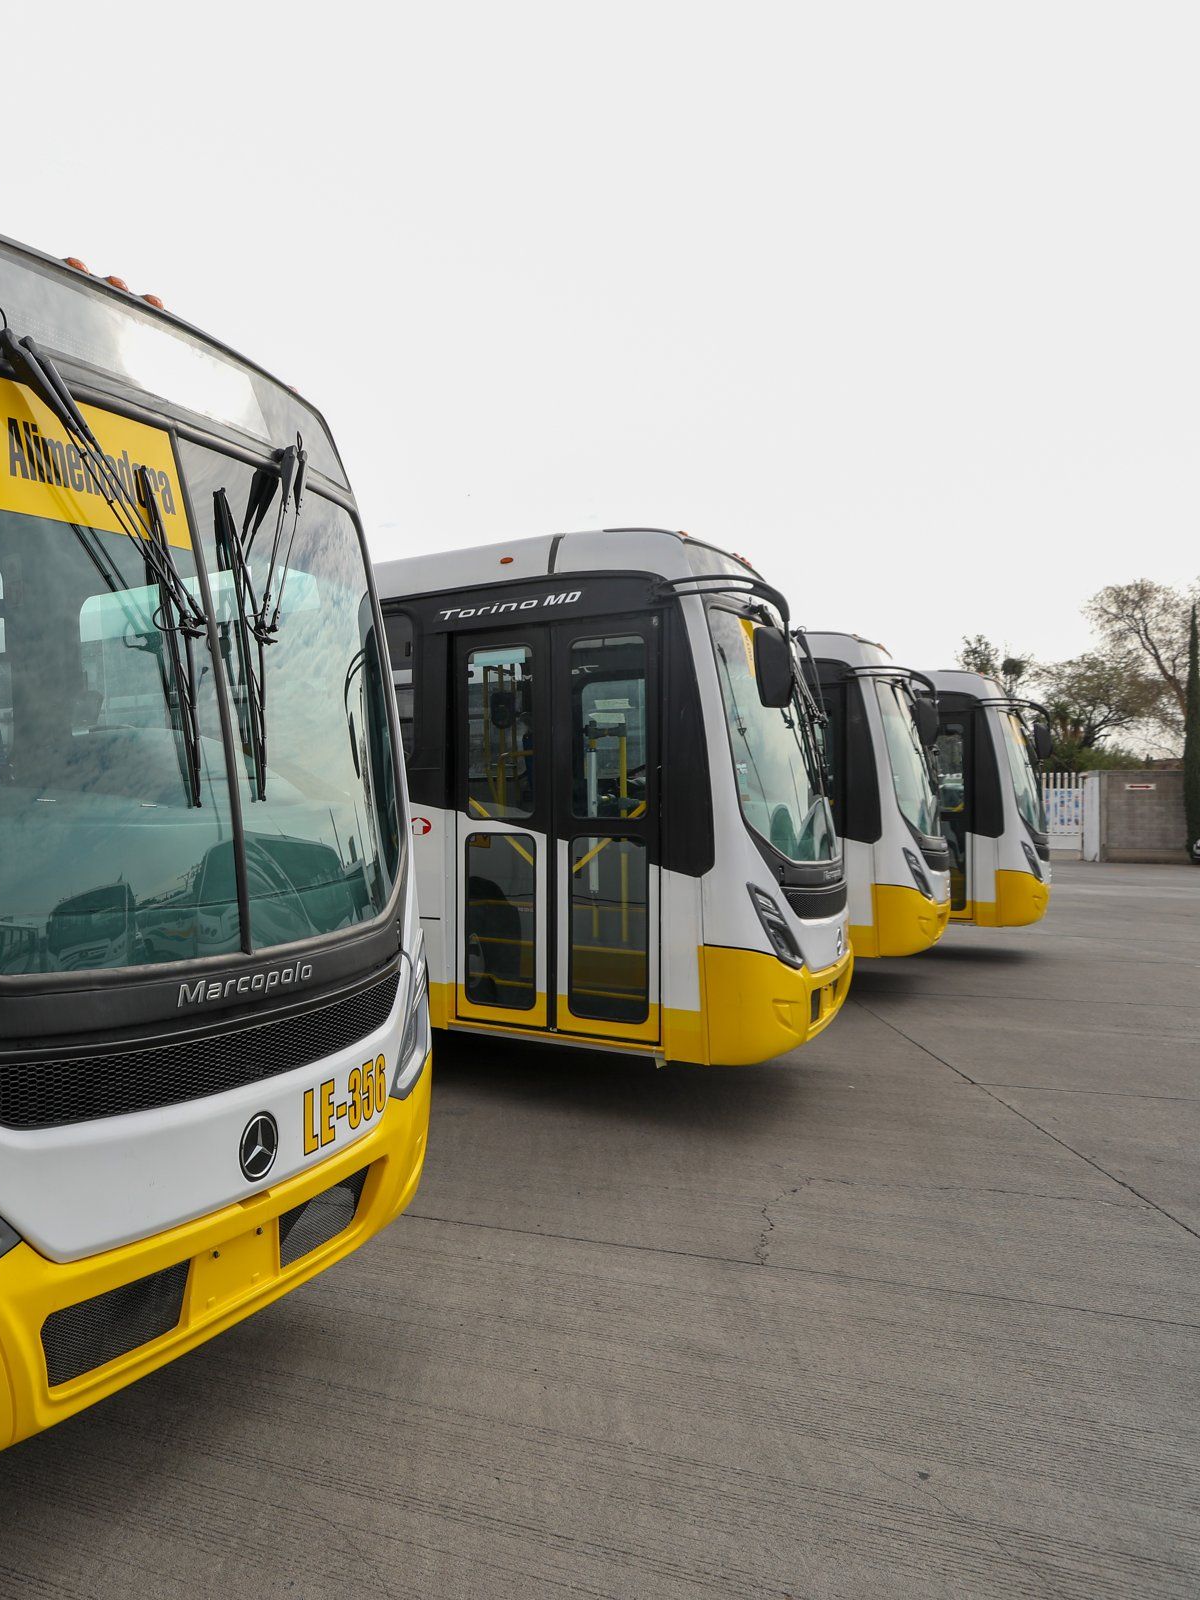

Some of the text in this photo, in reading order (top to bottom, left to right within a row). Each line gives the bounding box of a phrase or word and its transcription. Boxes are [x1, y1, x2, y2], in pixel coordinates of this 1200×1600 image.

[439, 590, 582, 621] Torino MD
[177, 961, 313, 1008] Marcopolo
[303, 1053, 387, 1156] LE-356
